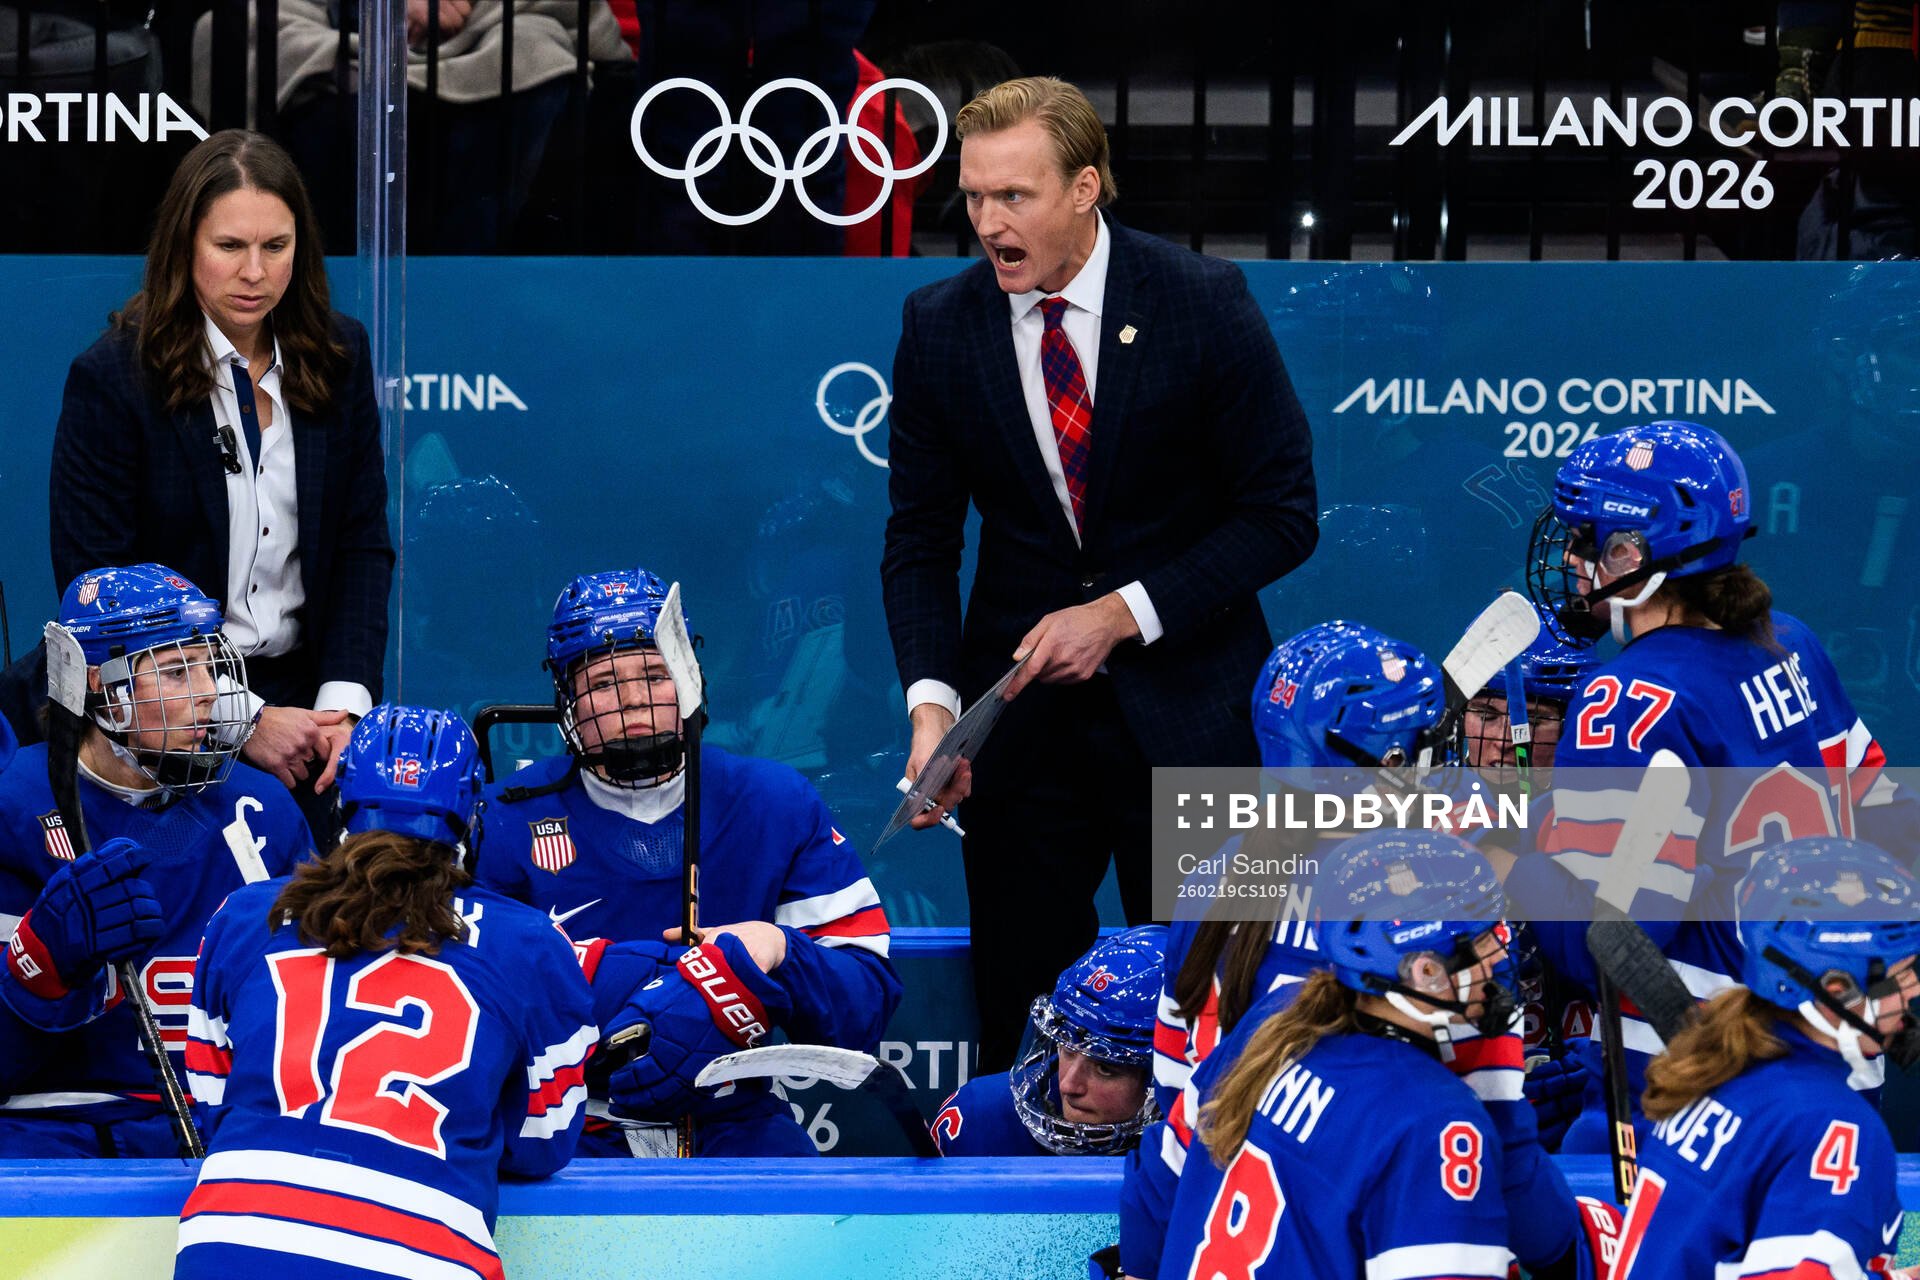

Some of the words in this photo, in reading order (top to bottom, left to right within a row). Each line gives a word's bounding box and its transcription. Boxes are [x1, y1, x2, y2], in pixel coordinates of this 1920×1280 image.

[0, 92, 209, 142] RTINA
[1389, 96, 1693, 147] MILANO
[1709, 97, 1920, 147] CORTI
[1632, 160, 1775, 209] 2026
[1333, 378, 1547, 414] MILANO
[1557, 378, 1776, 414] CORTINA
[1603, 501, 1649, 517] CCM
[604, 583, 627, 597] 17
[1270, 678, 1299, 709] 24
[1575, 674, 1677, 753] 27
[394, 758, 421, 785] 12
[45, 815, 63, 828] US
[536, 821, 563, 837] USA
[1393, 920, 1443, 944] CCM
[1085, 965, 1116, 992] 16
[265, 947, 481, 1160] 12
[1440, 1121, 1483, 1201] 8
[1810, 1119, 1860, 1195] 4
[1186, 1139, 1287, 1280] 8
